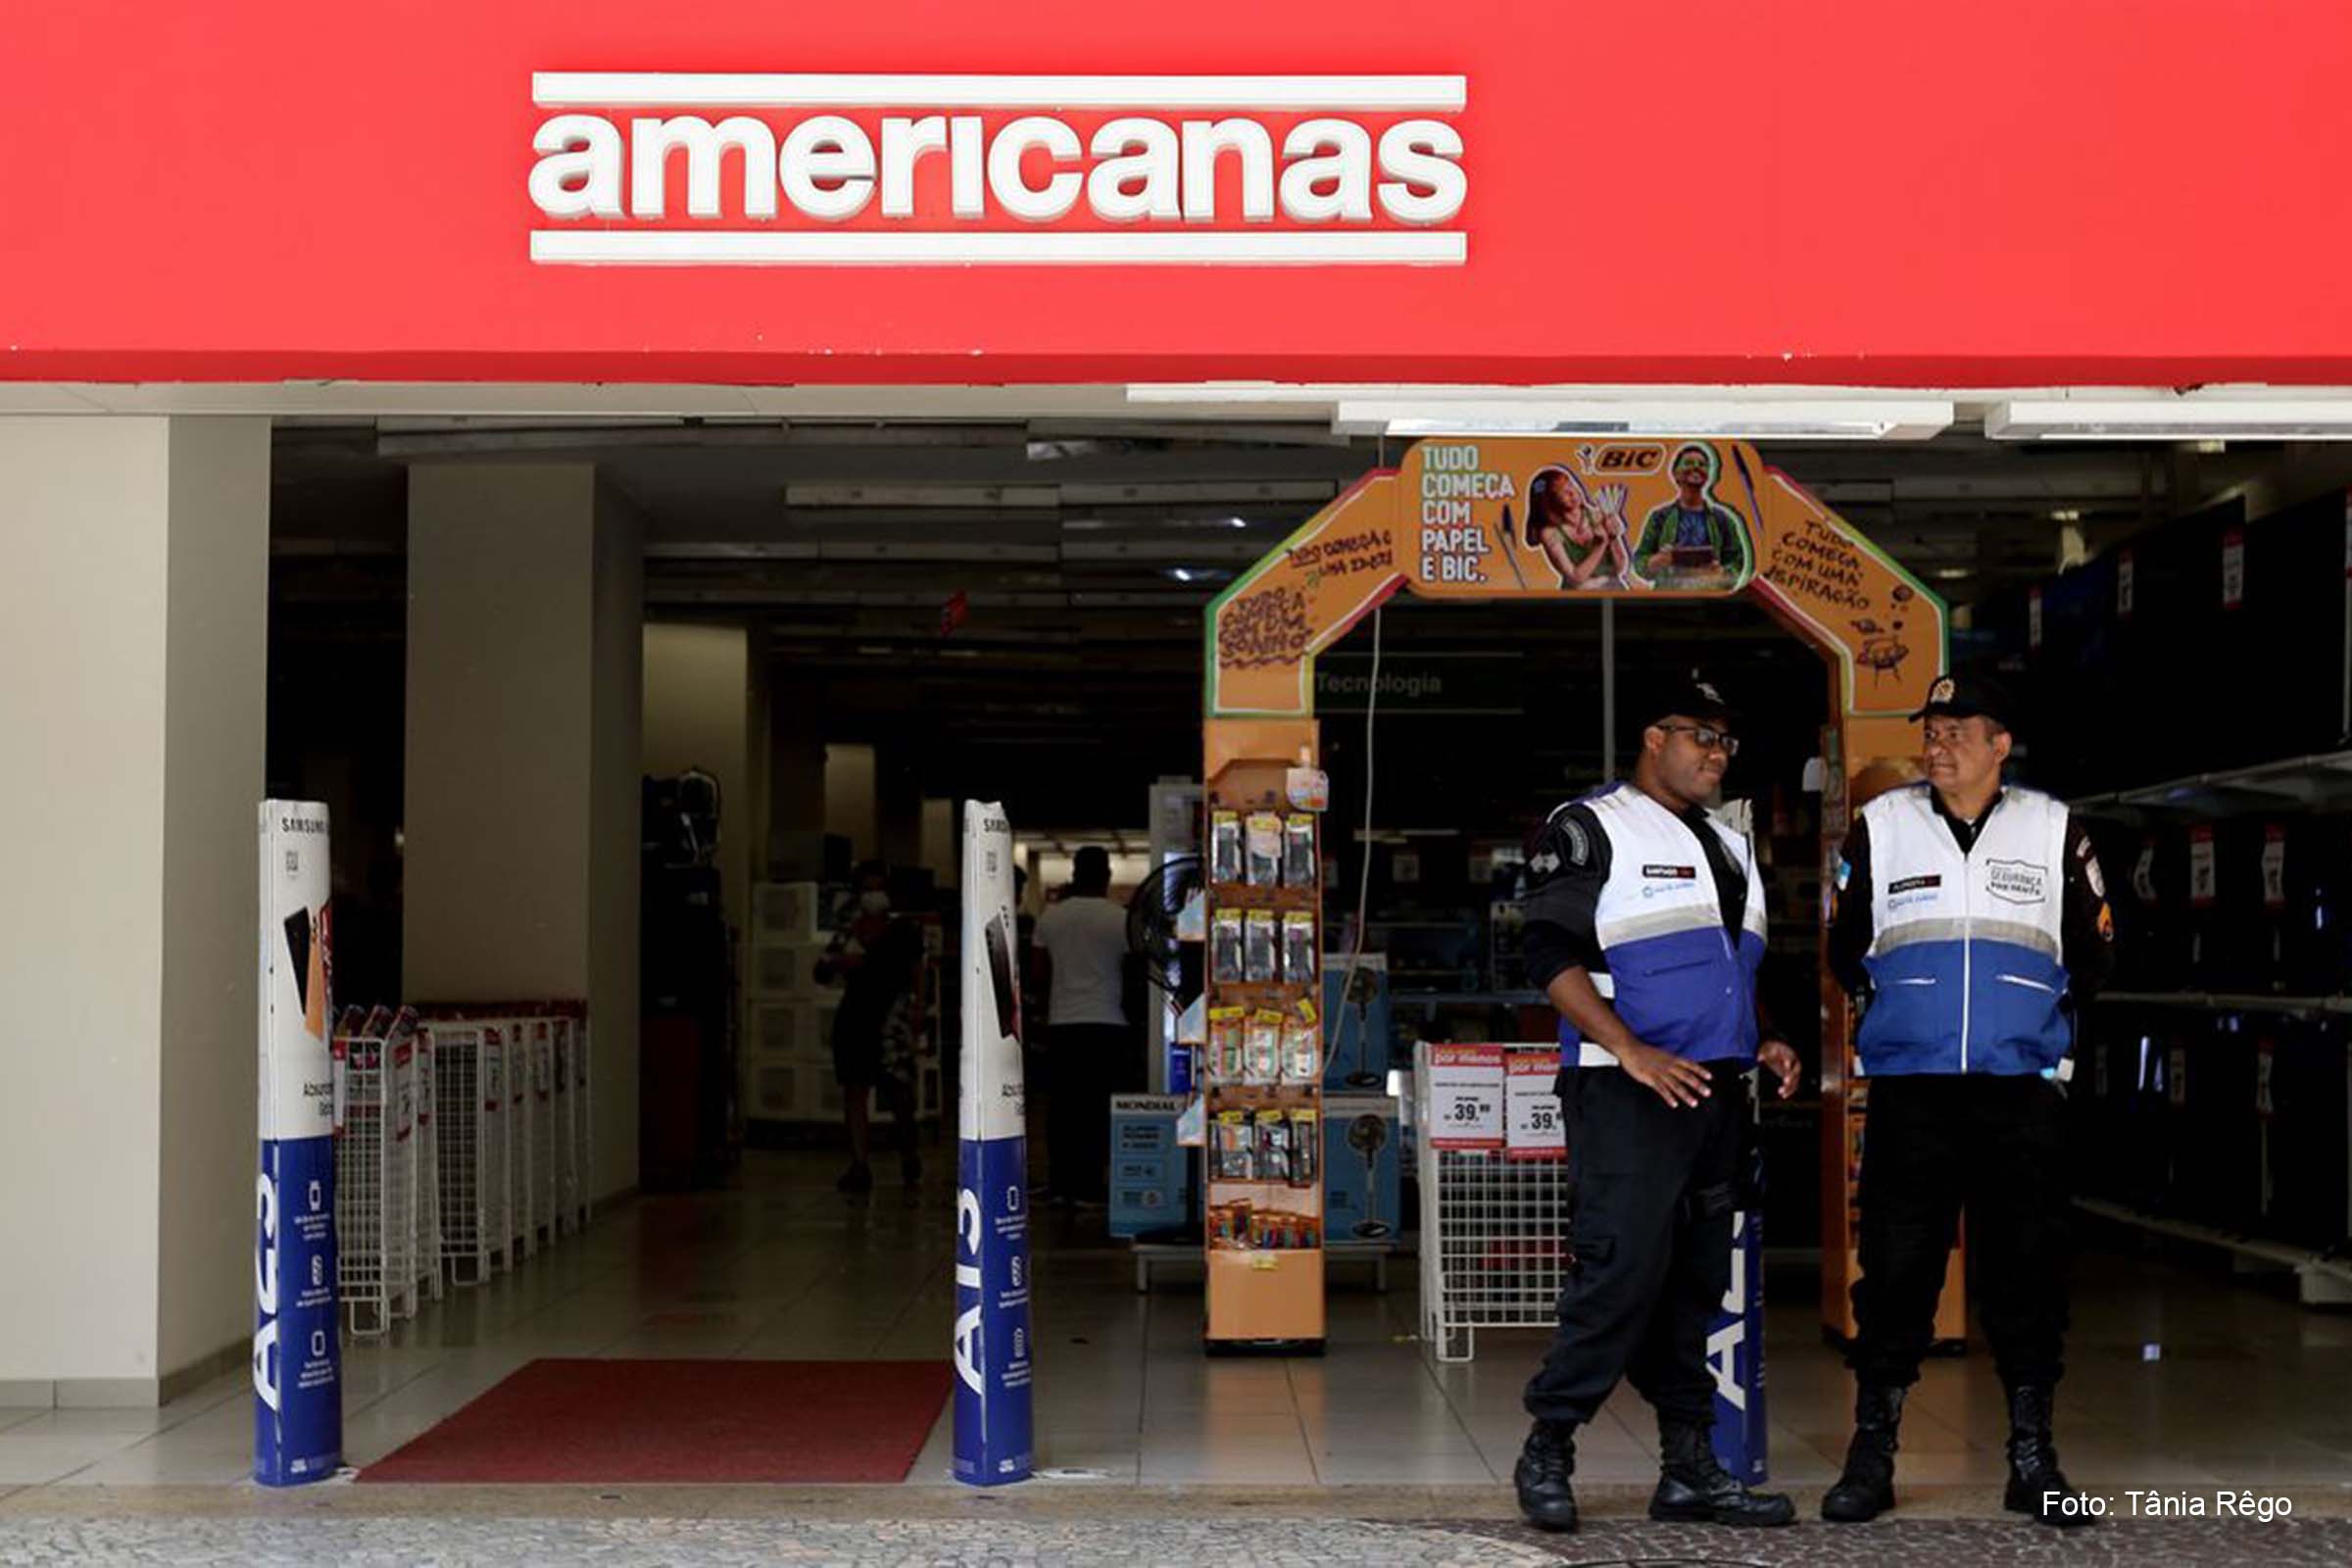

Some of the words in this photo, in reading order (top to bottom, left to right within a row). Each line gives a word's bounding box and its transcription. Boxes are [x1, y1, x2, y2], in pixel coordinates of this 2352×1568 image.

[528, 114, 1468, 224] americanas
[1422, 445, 1478, 471] TUDO
[1600, 450, 1659, 469] BIC
[1422, 473, 1516, 500] COMEÇA
[1422, 501, 1471, 525] COM
[1422, 528, 1490, 554] PAPEL
[1422, 557, 1435, 581] E
[1316, 671, 1443, 698] Tecnologia
[281, 817, 330, 833] SAMSUN
